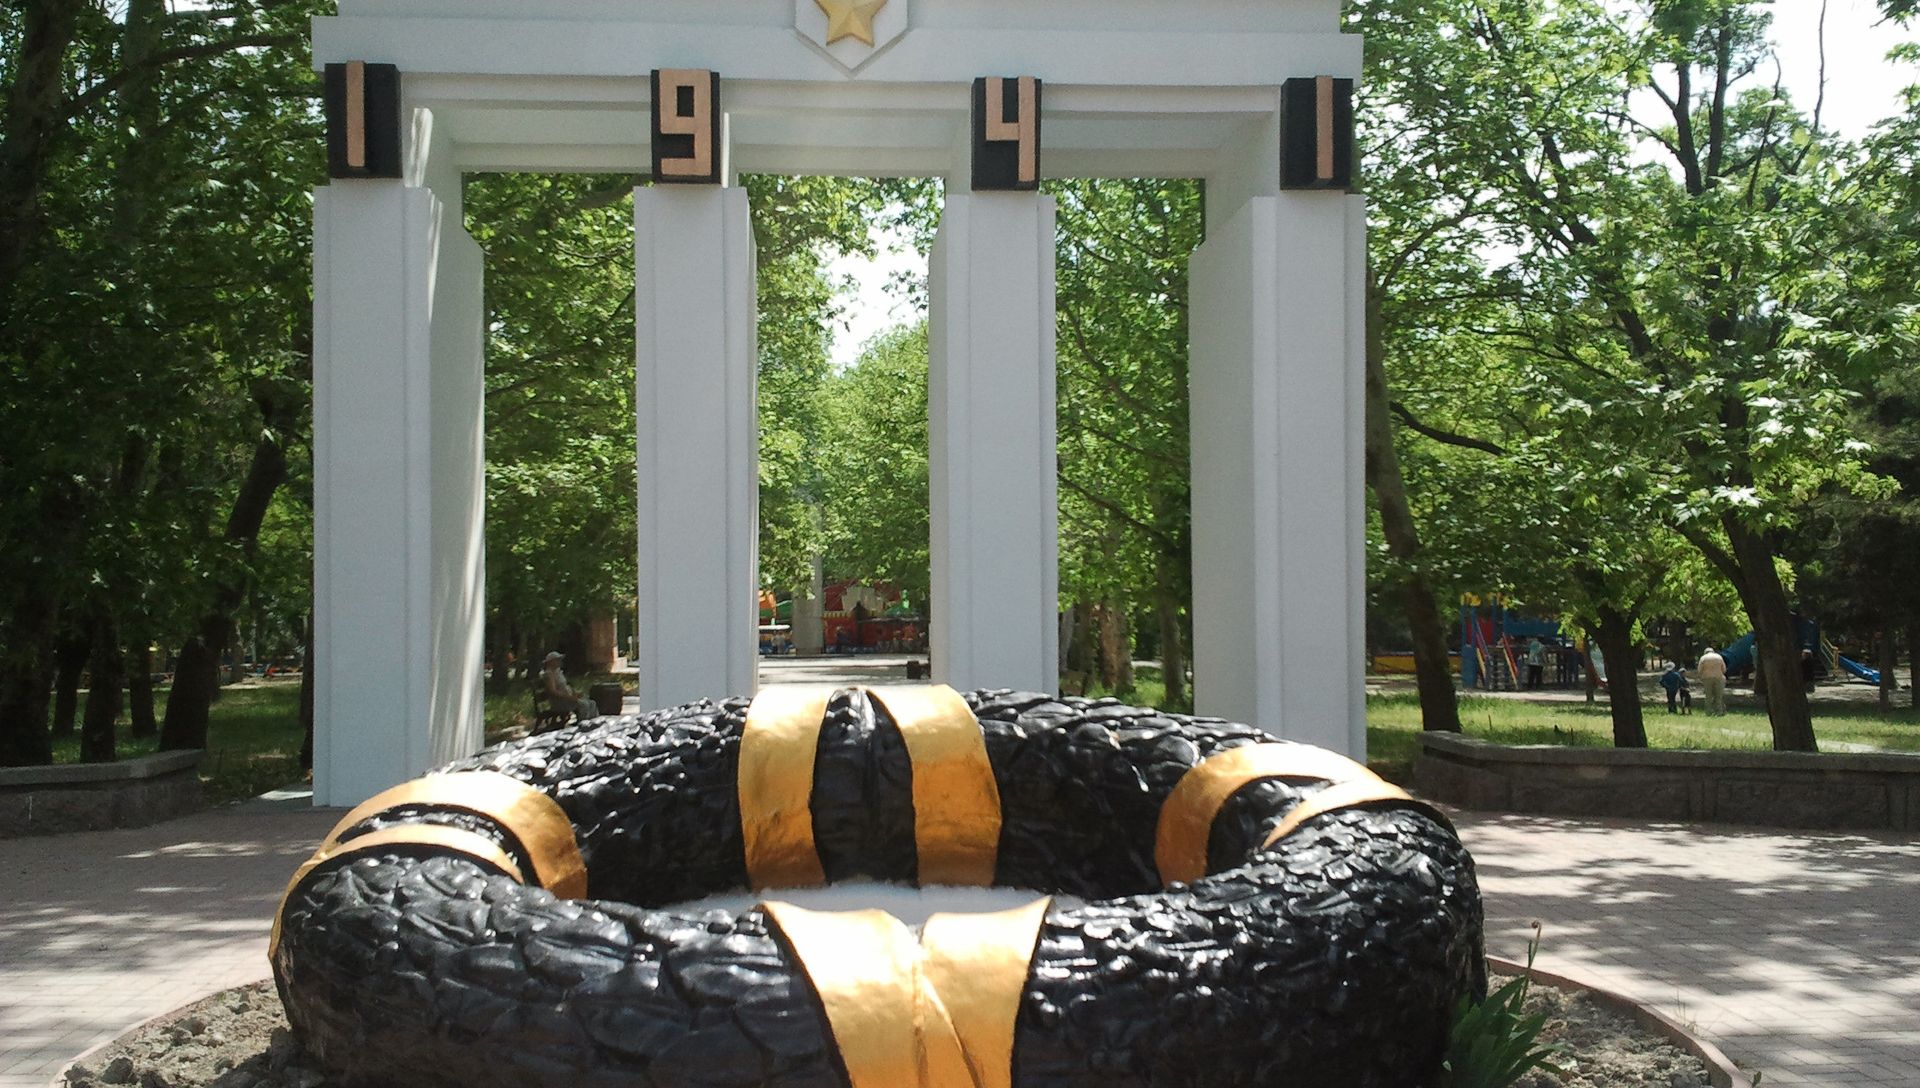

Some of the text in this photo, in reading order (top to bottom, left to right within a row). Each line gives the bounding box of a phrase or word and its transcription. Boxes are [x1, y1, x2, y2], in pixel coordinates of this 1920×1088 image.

[346, 60, 1333, 182] 1 9 4 1
